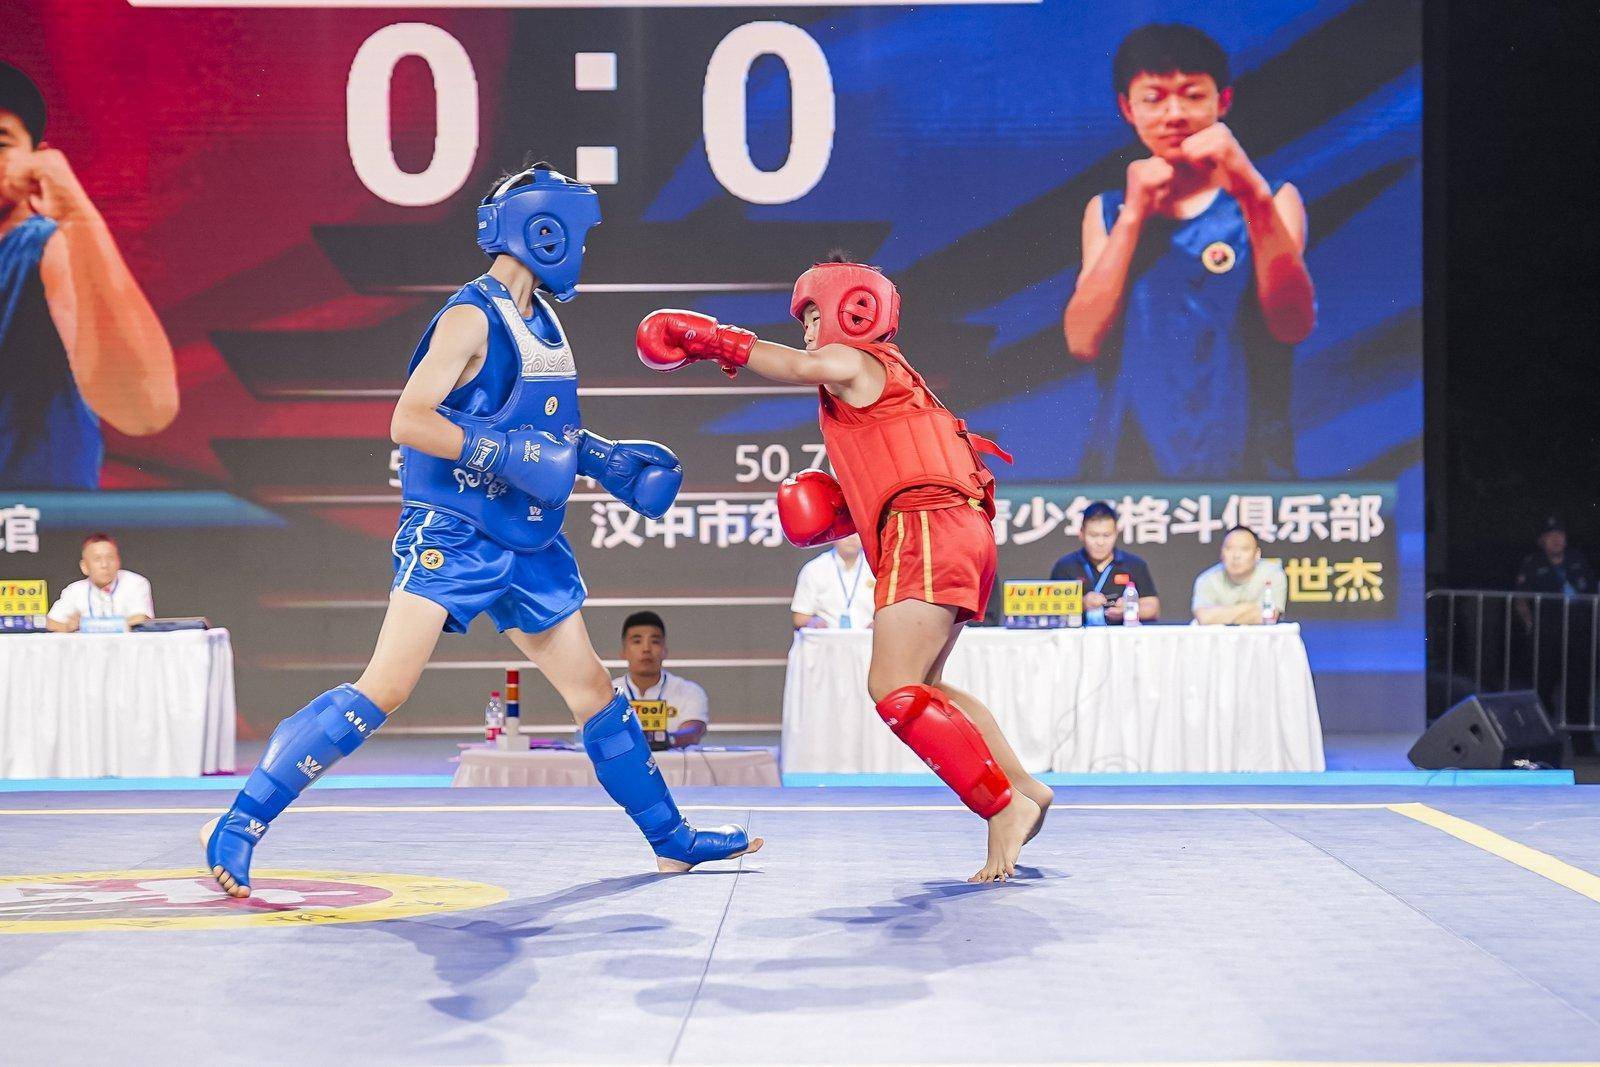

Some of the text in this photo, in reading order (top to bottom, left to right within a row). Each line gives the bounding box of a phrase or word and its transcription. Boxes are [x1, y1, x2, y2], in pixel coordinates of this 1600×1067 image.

[346, 22, 479, 206] 0
[703, 20, 836, 204] 0
[735, 443, 838, 482] 50.7
[1262, 556, 1385, 602] 世杰
